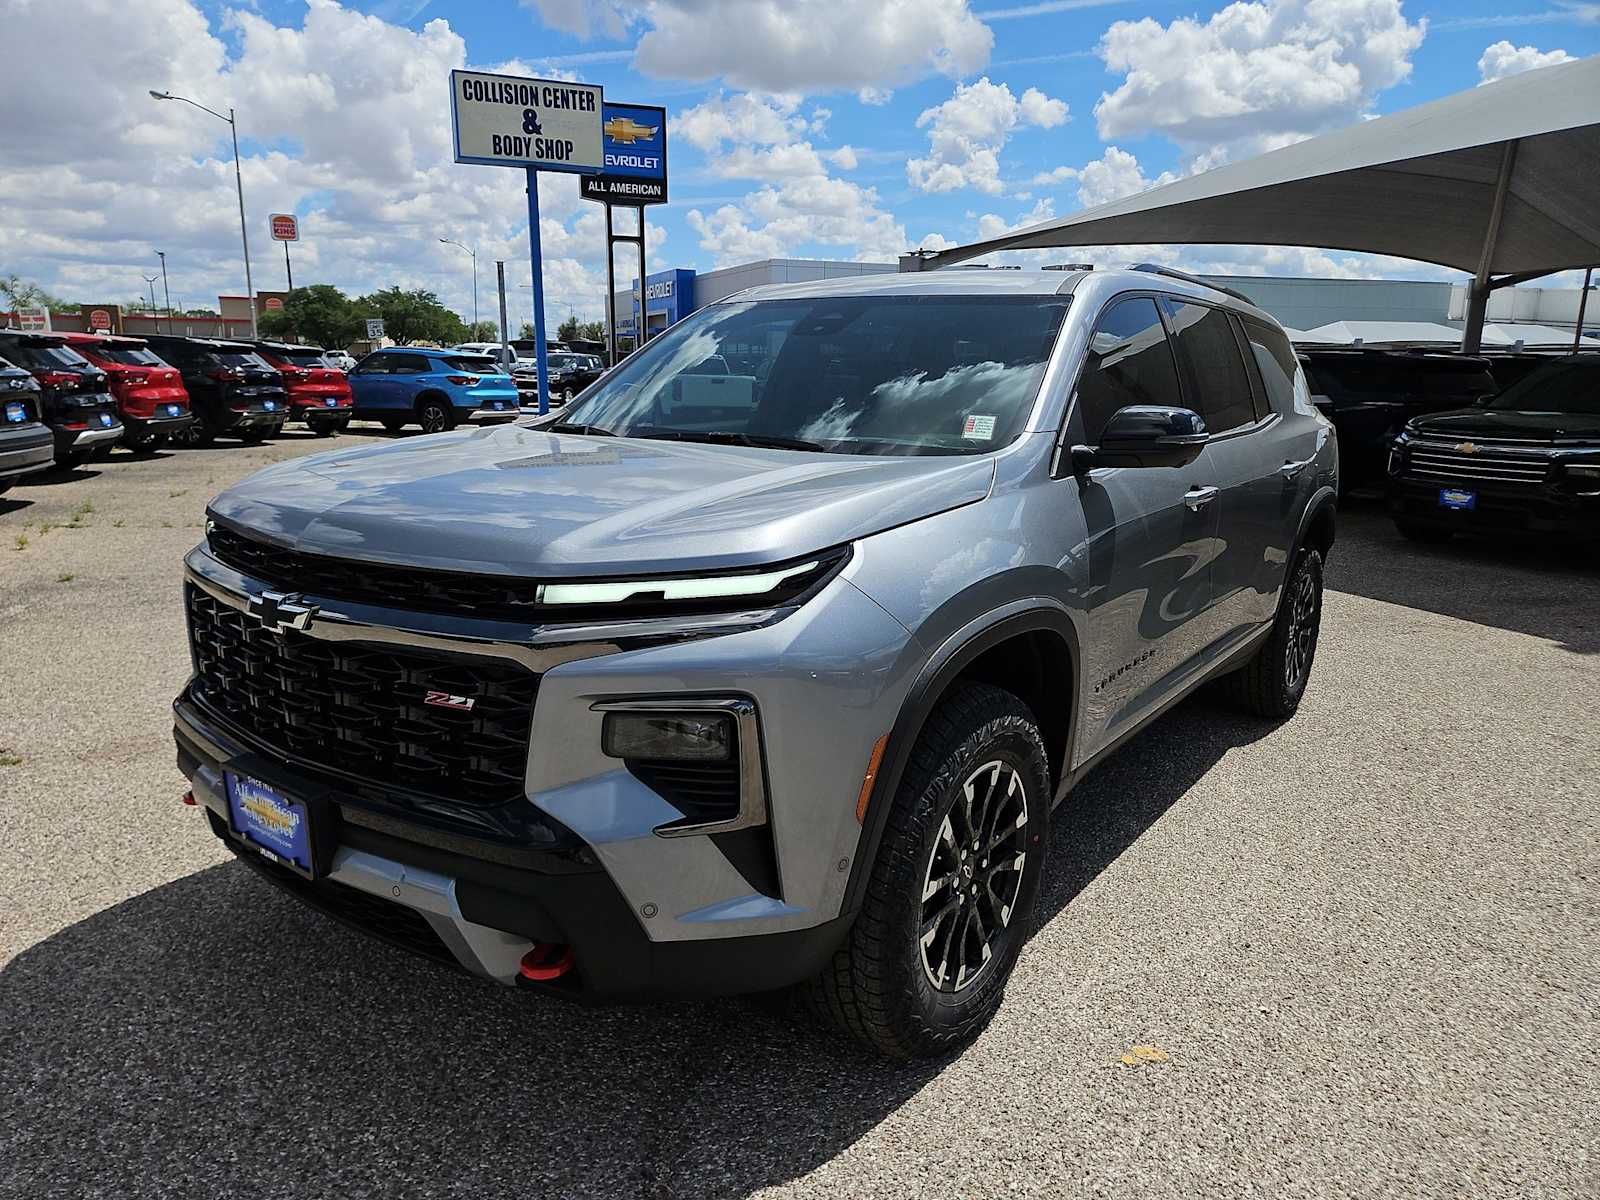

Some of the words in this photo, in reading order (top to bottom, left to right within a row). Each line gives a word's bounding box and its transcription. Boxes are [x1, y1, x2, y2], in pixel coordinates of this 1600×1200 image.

[462, 79, 539, 107] COLLISION
[542, 87, 596, 112] CENTER
[522, 108, 543, 136] &
[492, 134, 532, 158] BODY
[535, 138, 574, 161] SHOP
[604, 154, 659, 169] EVROLET
[587, 180, 608, 192] ALL
[609, 182, 662, 196] AMERICAN
[274, 228, 296, 236] KING
[646, 281, 673, 300] HEVROLET
[369, 329, 383, 337] 35
[423, 690, 476, 711] Z71
